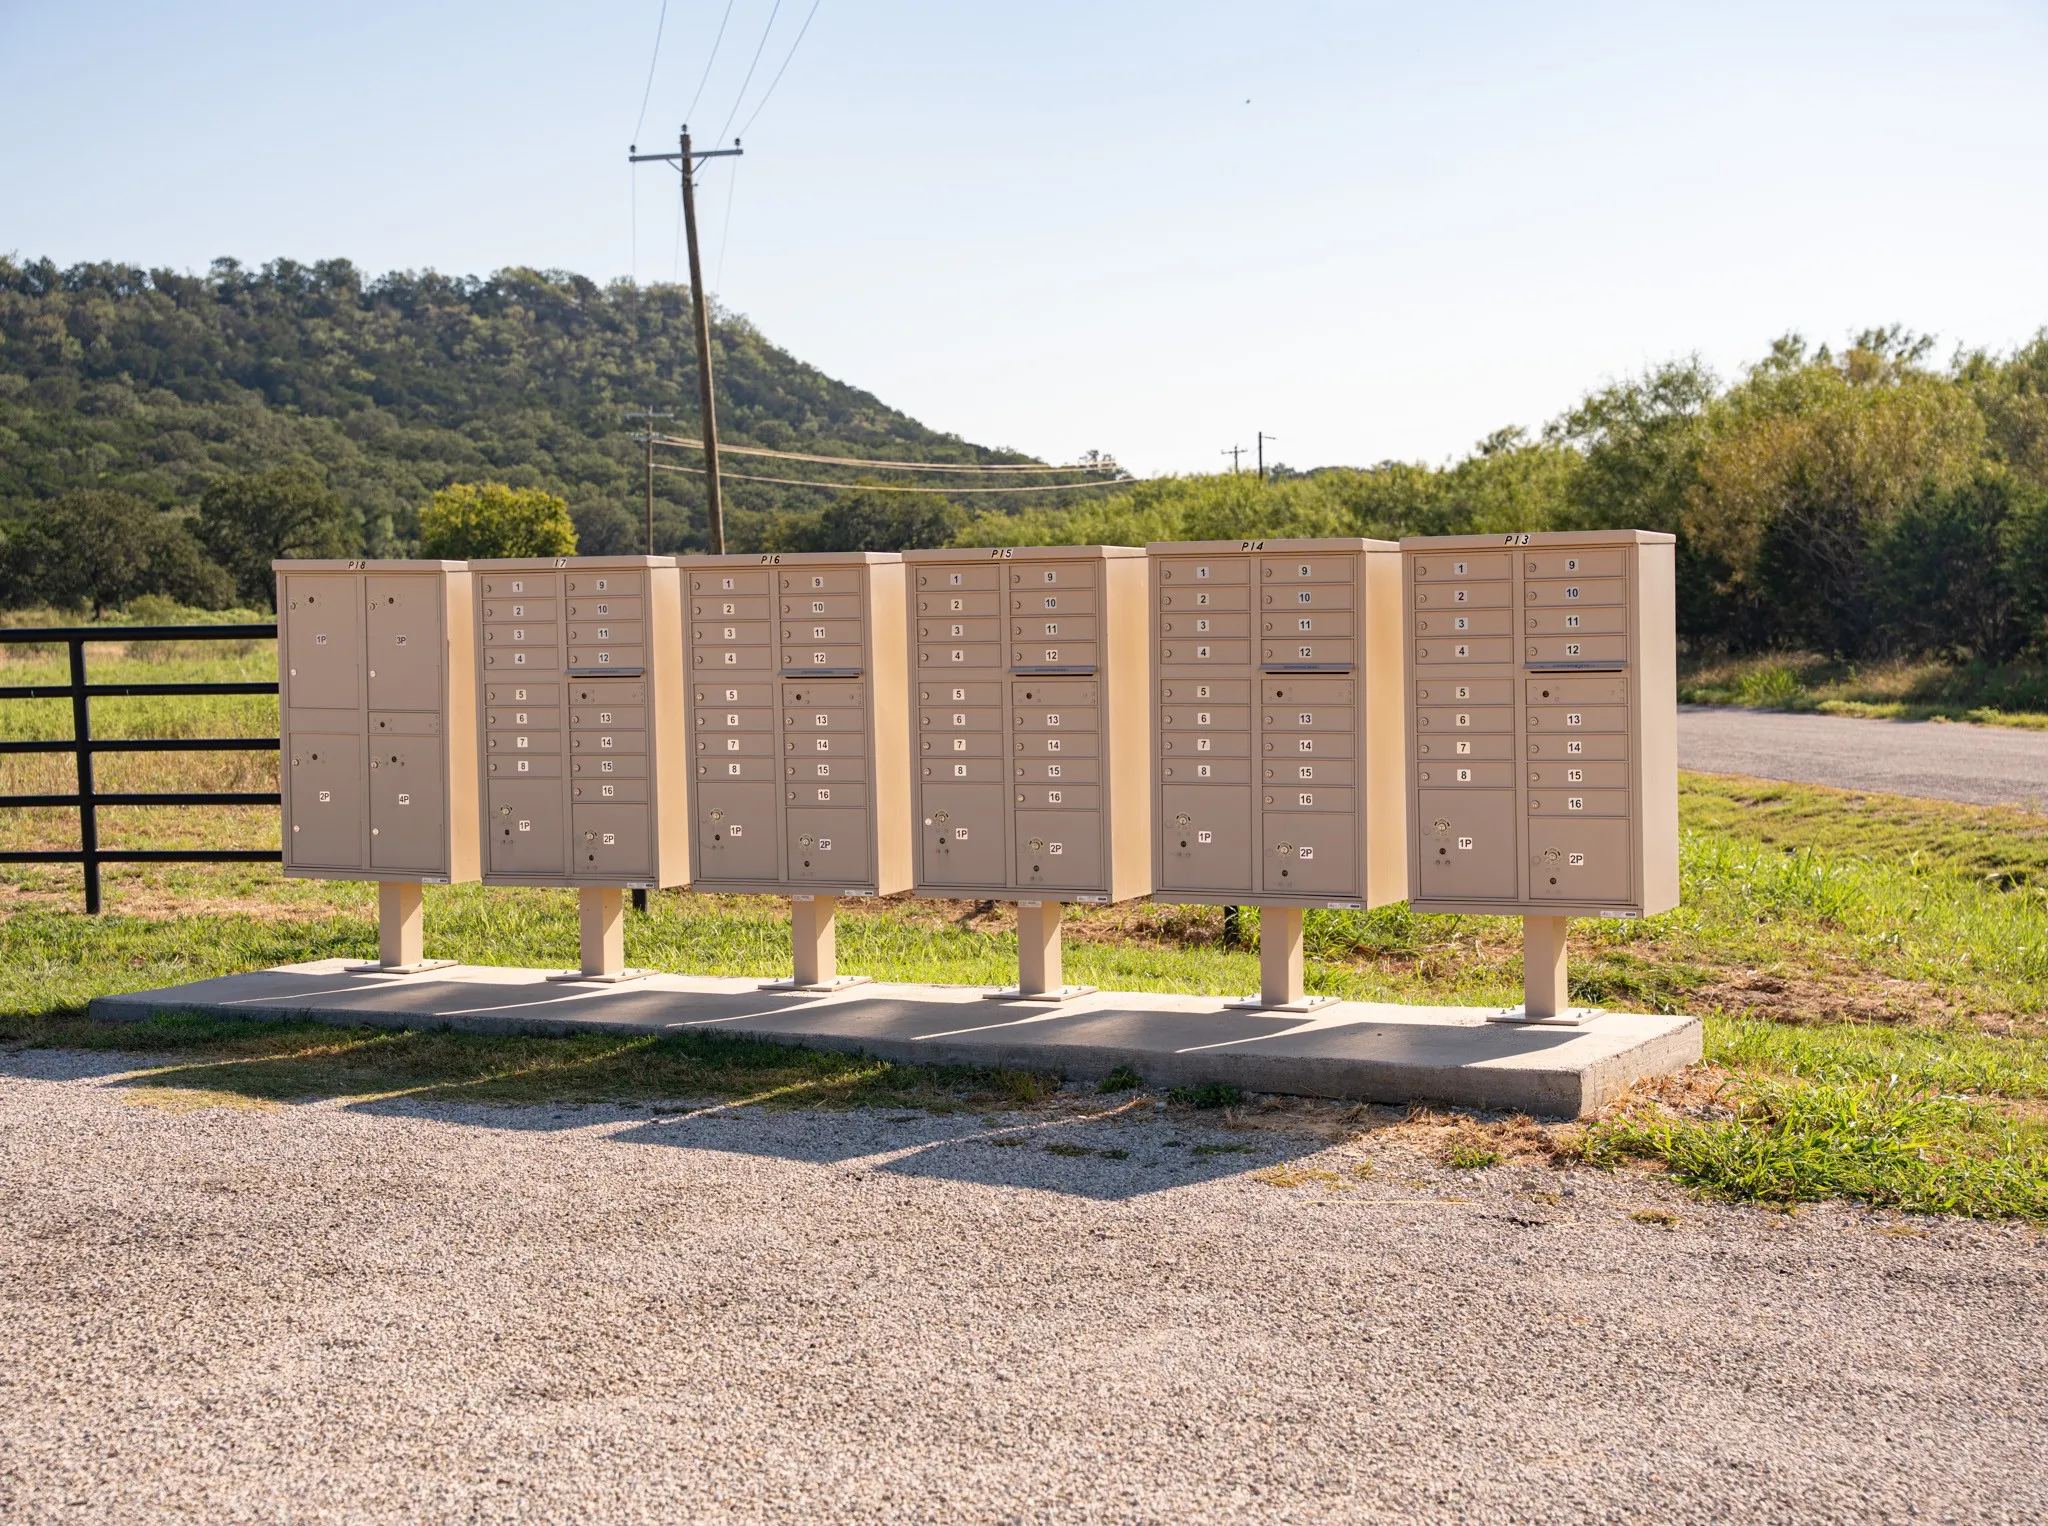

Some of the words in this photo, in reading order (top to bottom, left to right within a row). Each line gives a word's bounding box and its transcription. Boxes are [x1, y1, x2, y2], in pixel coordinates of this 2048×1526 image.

[1566, 588, 1579, 598] 10
[1300, 593, 1310, 602] 10
[1046, 598, 1056, 608] 10
[598, 605, 608, 613] 10
[813, 603, 824, 612] 10
[1300, 620, 1310, 629] 11
[1567, 616, 1578, 626] 11
[599, 629, 608, 637] 11
[814, 629, 824, 637] 11
[1047, 625, 1056, 633] 11
[396, 636, 406, 644] 3P
[1300, 648, 1311, 657] 12
[1567, 645, 1579, 654] 12
[599, 654, 609, 662] 12
[815, 654, 825, 662] 12
[1047, 651, 1057, 660] 12
[601, 714, 611, 722] 13
[817, 716, 827, 724] 13
[1048, 716, 1059, 724] 13
[1300, 714, 1311, 724] 13
[1568, 715, 1581, 724] 13
[602, 738, 611, 746] 14
[817, 741, 828, 749] 14
[1049, 741, 1059, 749] 14
[1300, 741, 1312, 750] 14
[1568, 743, 1580, 752] 14
[603, 762, 612, 770] 15
[818, 766, 828, 774] 15
[1049, 767, 1060, 775] 15
[1300, 768, 1312, 777] 15
[1569, 771, 1582, 780] 15
[320, 792, 330, 800] 2P
[819, 791, 829, 799] 16
[1050, 793, 1060, 801] 16
[1300, 795, 1312, 804] 16
[1570, 799, 1582, 808] 16
[731, 827, 742, 835] 1P
[956, 830, 968, 838] 1P
[1199, 833, 1211, 841] 1P
[820, 841, 830, 849] 2P
[1459, 839, 1472, 848] 1P
[1050, 844, 1062, 853] 2P
[1300, 848, 1313, 857] 2P
[1570, 854, 1583, 864] 2P
